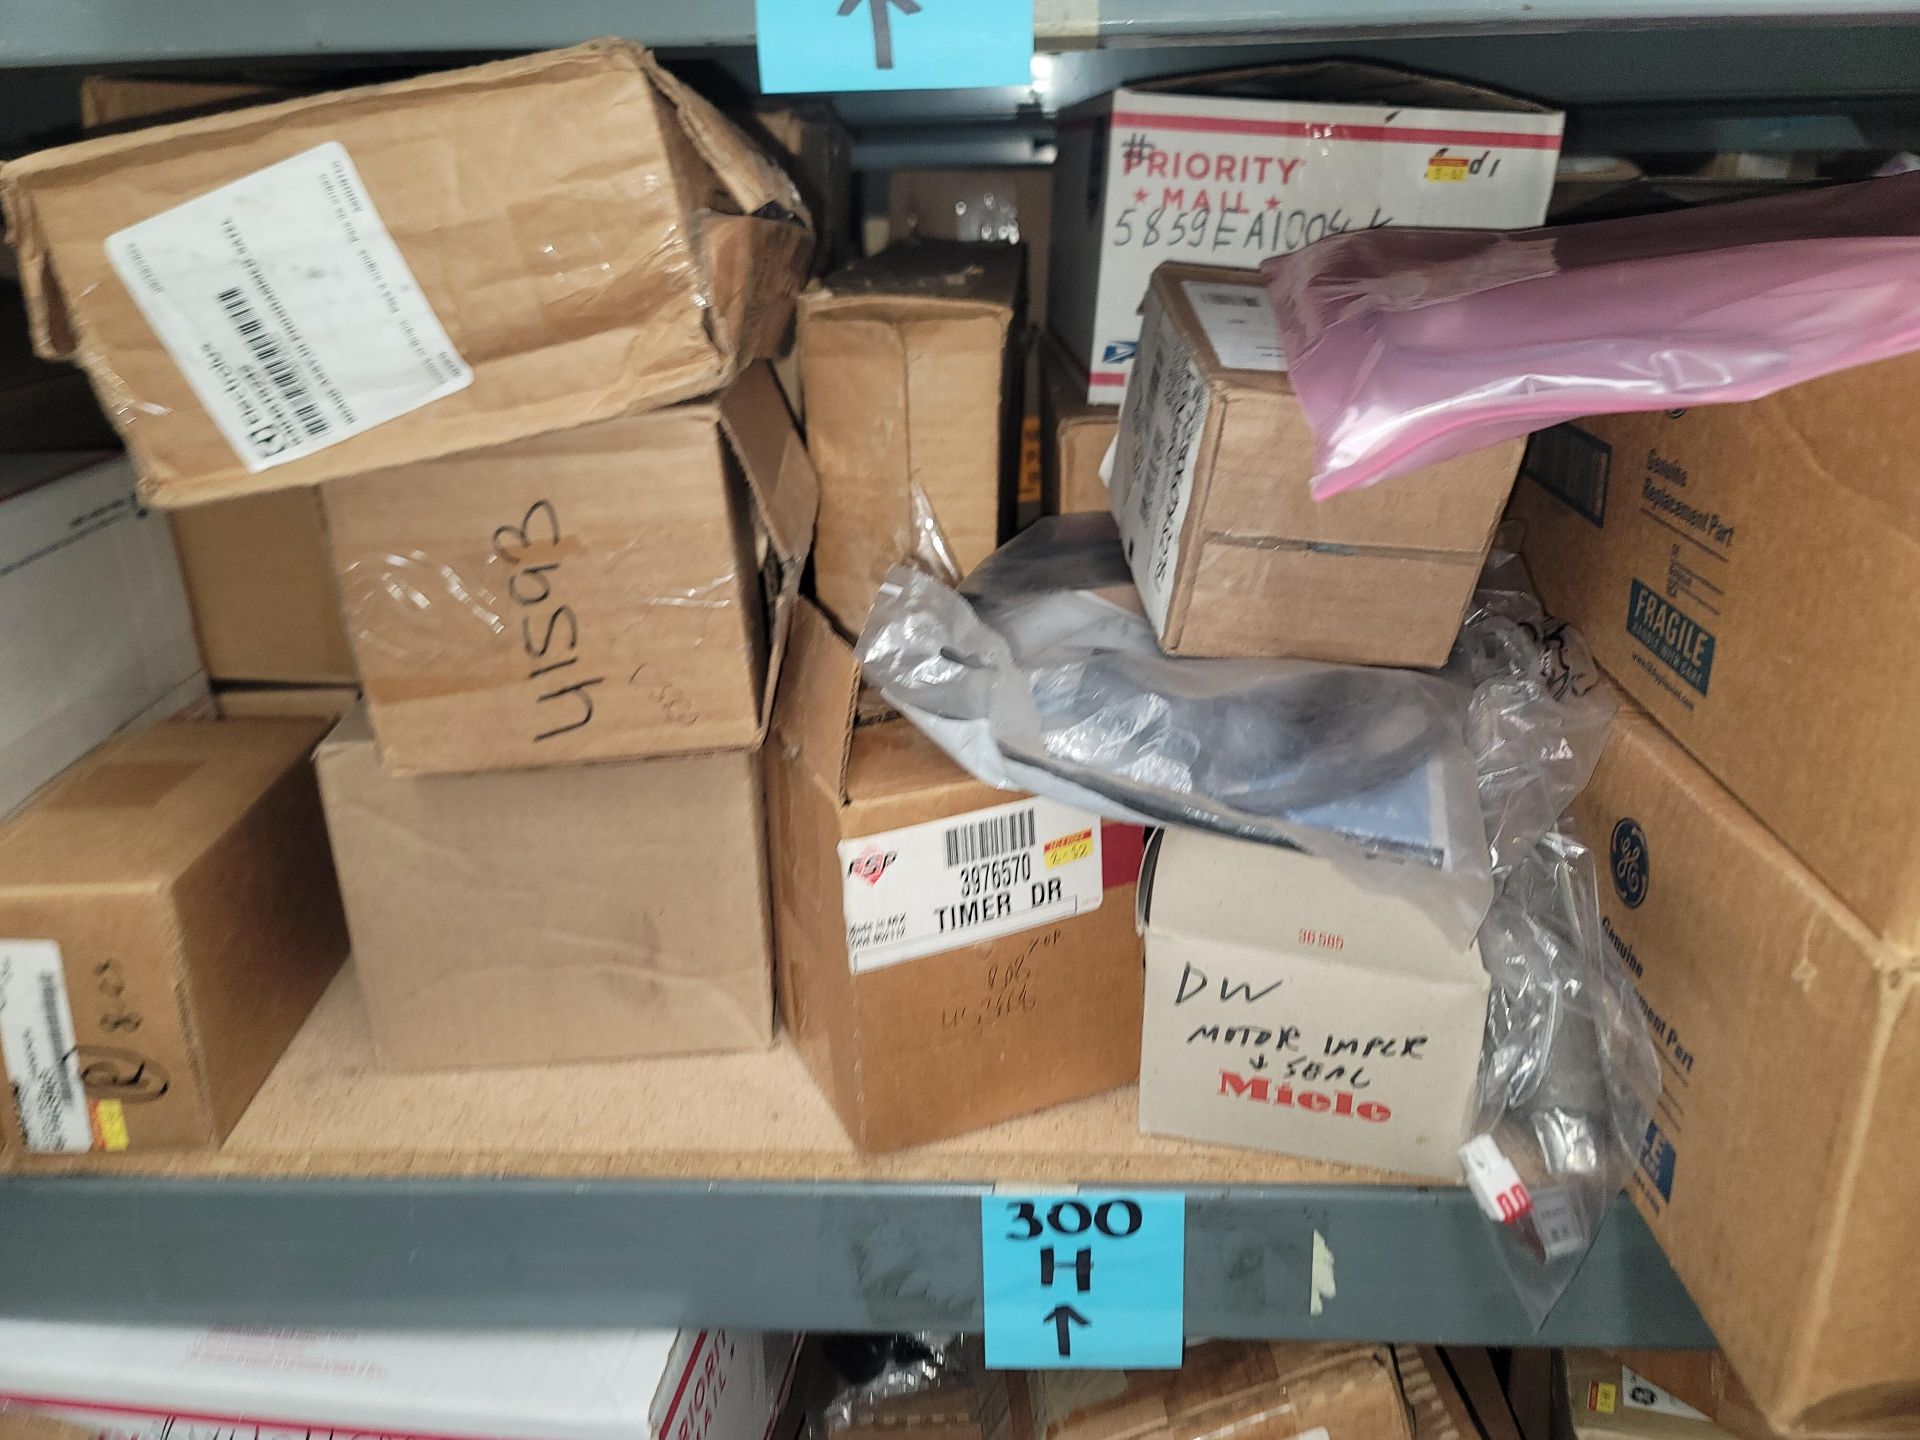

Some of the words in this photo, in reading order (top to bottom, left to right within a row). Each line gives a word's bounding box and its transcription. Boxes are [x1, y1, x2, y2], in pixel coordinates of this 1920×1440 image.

[1121, 146, 1301, 186] PRIORITY
[1161, 186, 1250, 214] MAIL
[1636, 588, 1708, 662] FRAGILE
[958, 852, 1032, 897] 3976570
[934, 892, 1012, 934] TIMER
[1030, 876, 1063, 909] DR
[1217, 1067, 1393, 1125] Miele
[1005, 1200, 1143, 1241] 300
[1040, 1245, 1094, 1294] H
